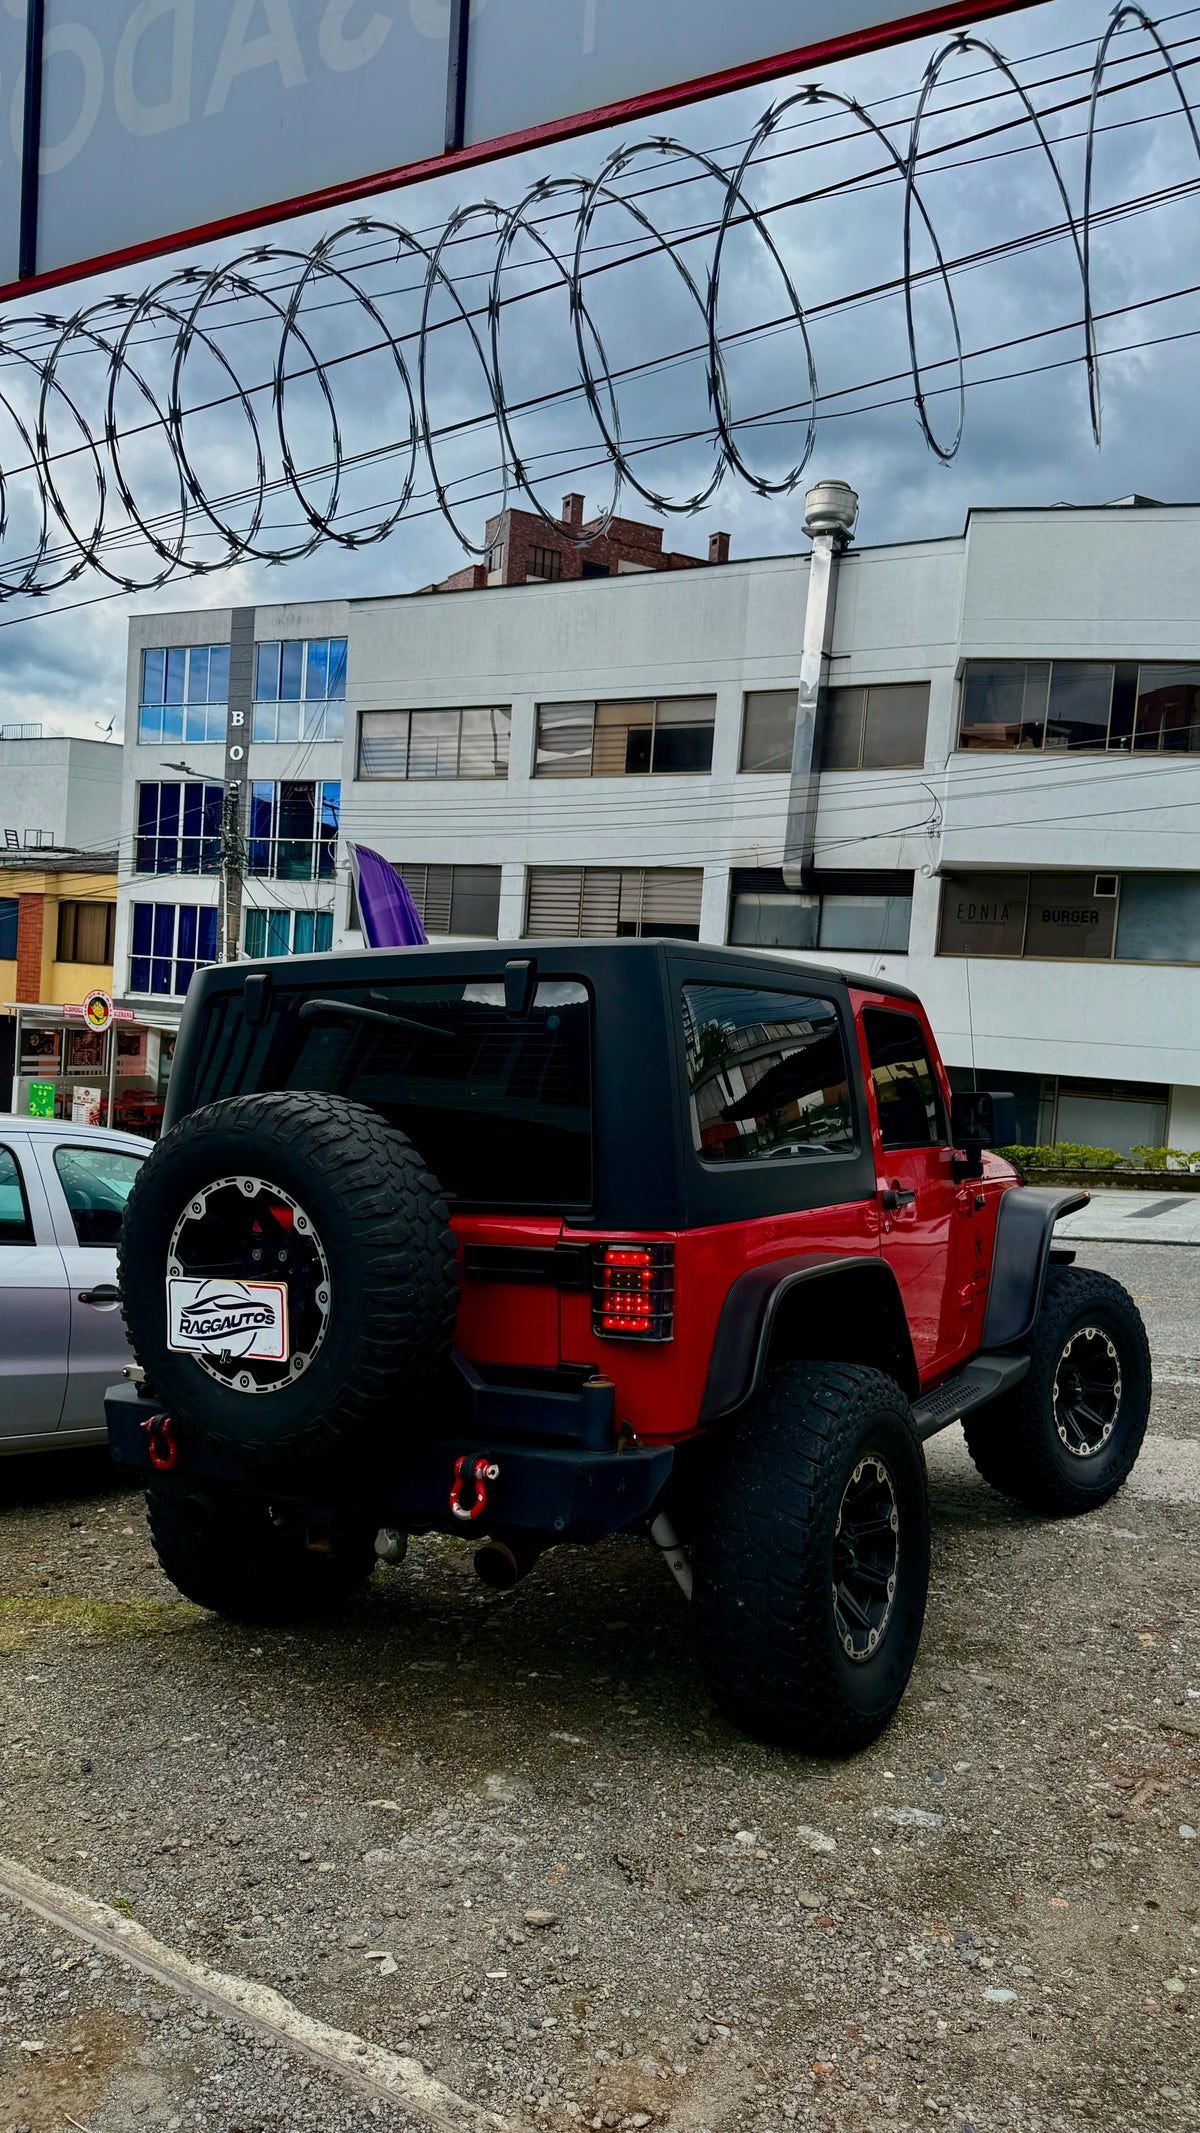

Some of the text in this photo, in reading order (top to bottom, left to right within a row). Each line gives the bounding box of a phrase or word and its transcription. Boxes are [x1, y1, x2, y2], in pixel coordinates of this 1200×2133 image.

[957, 903, 1009, 920] EDNIA
[1042, 909, 1099, 923] BURGER
[179, 1312, 276, 1334] RAGGAUTOS
